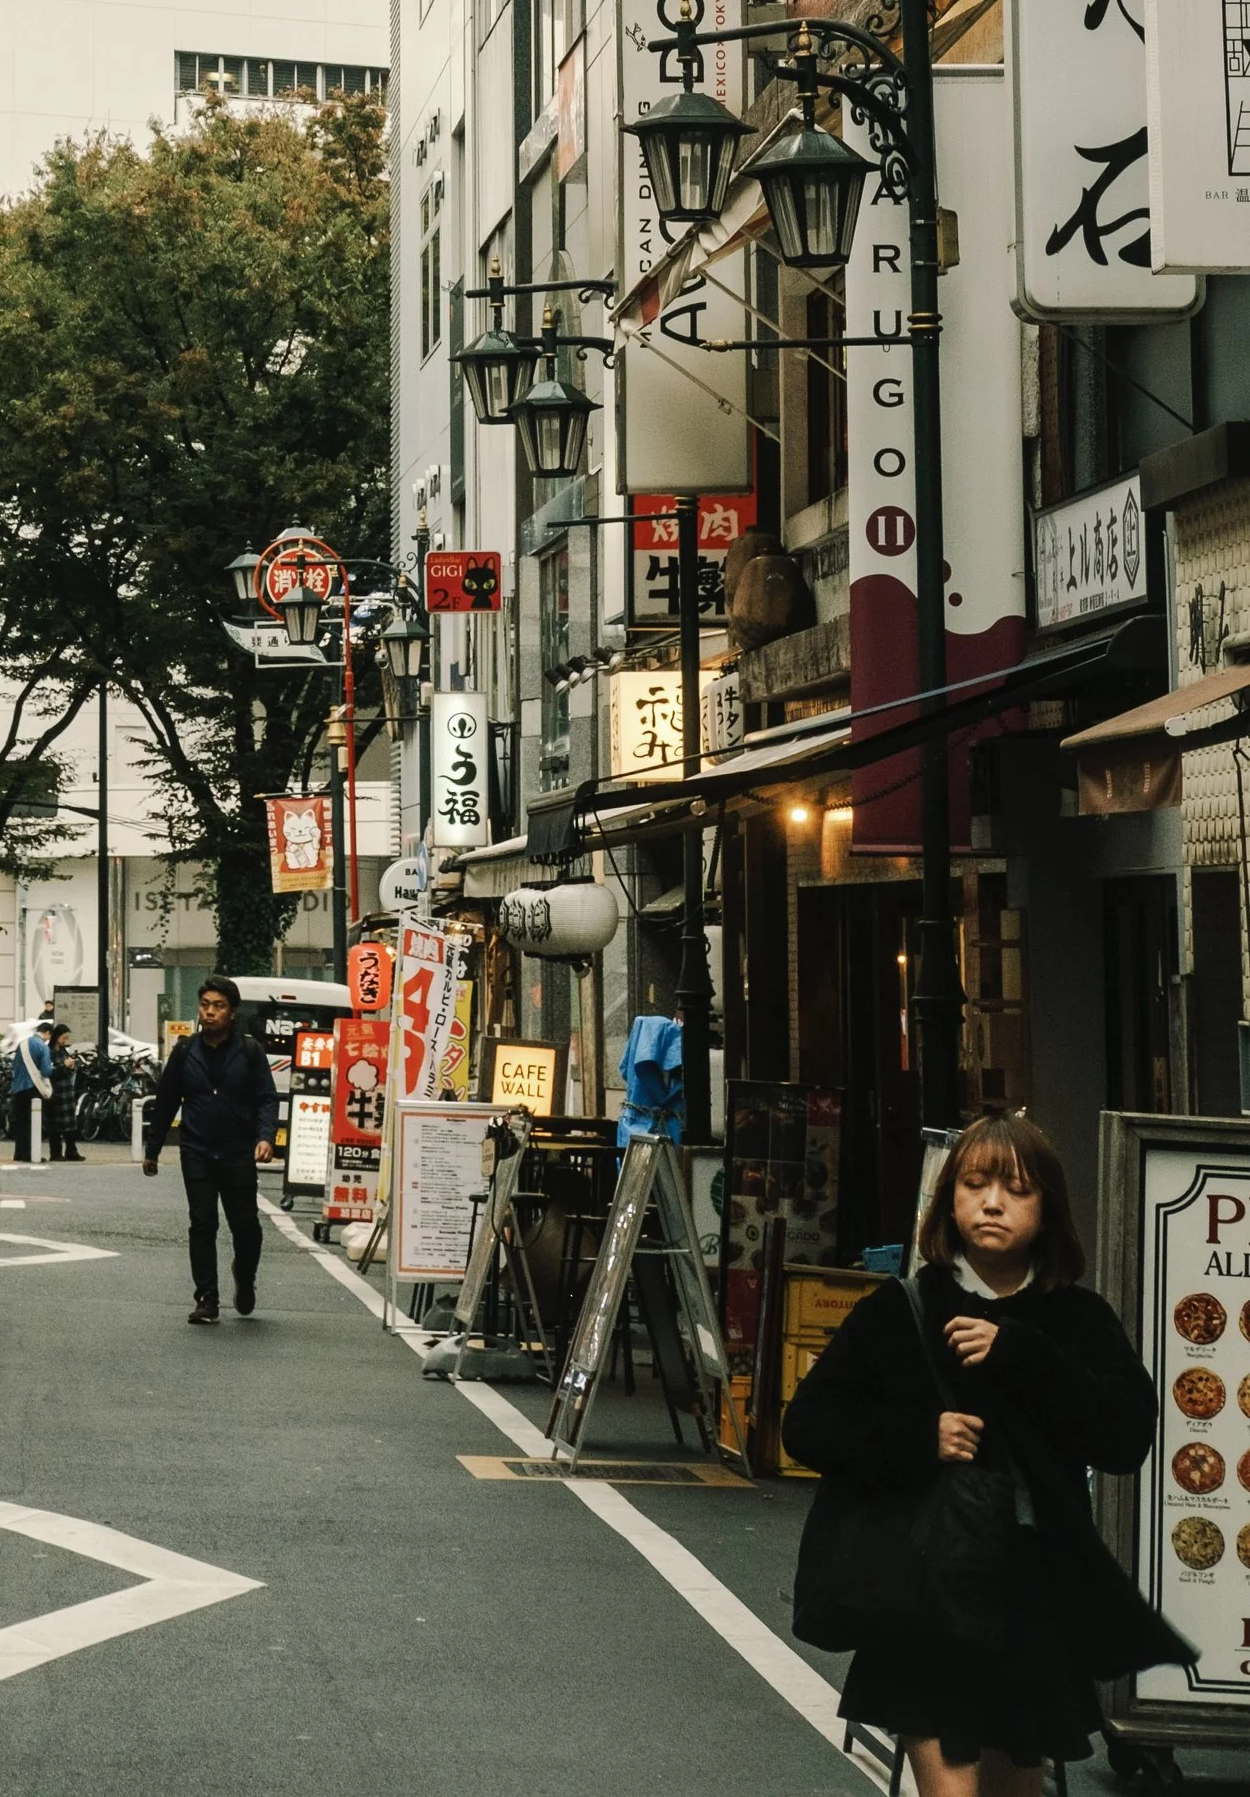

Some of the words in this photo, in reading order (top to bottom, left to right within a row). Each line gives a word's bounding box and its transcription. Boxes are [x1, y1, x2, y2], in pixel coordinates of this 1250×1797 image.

[1205, 190, 1229, 200] BAR
[870, 119, 907, 478] ARUGO
[430, 564, 463, 577] GIGI
[433, 588, 462, 610] 2F
[724, 685, 742, 747] 牛タン
[405, 868, 419, 876] BA
[301, 1050, 321, 1067] B1
[502, 1062, 547, 1081] CAFE
[501, 1081, 545, 1098] WALL
[333, 1185, 368, 1205] 無料
